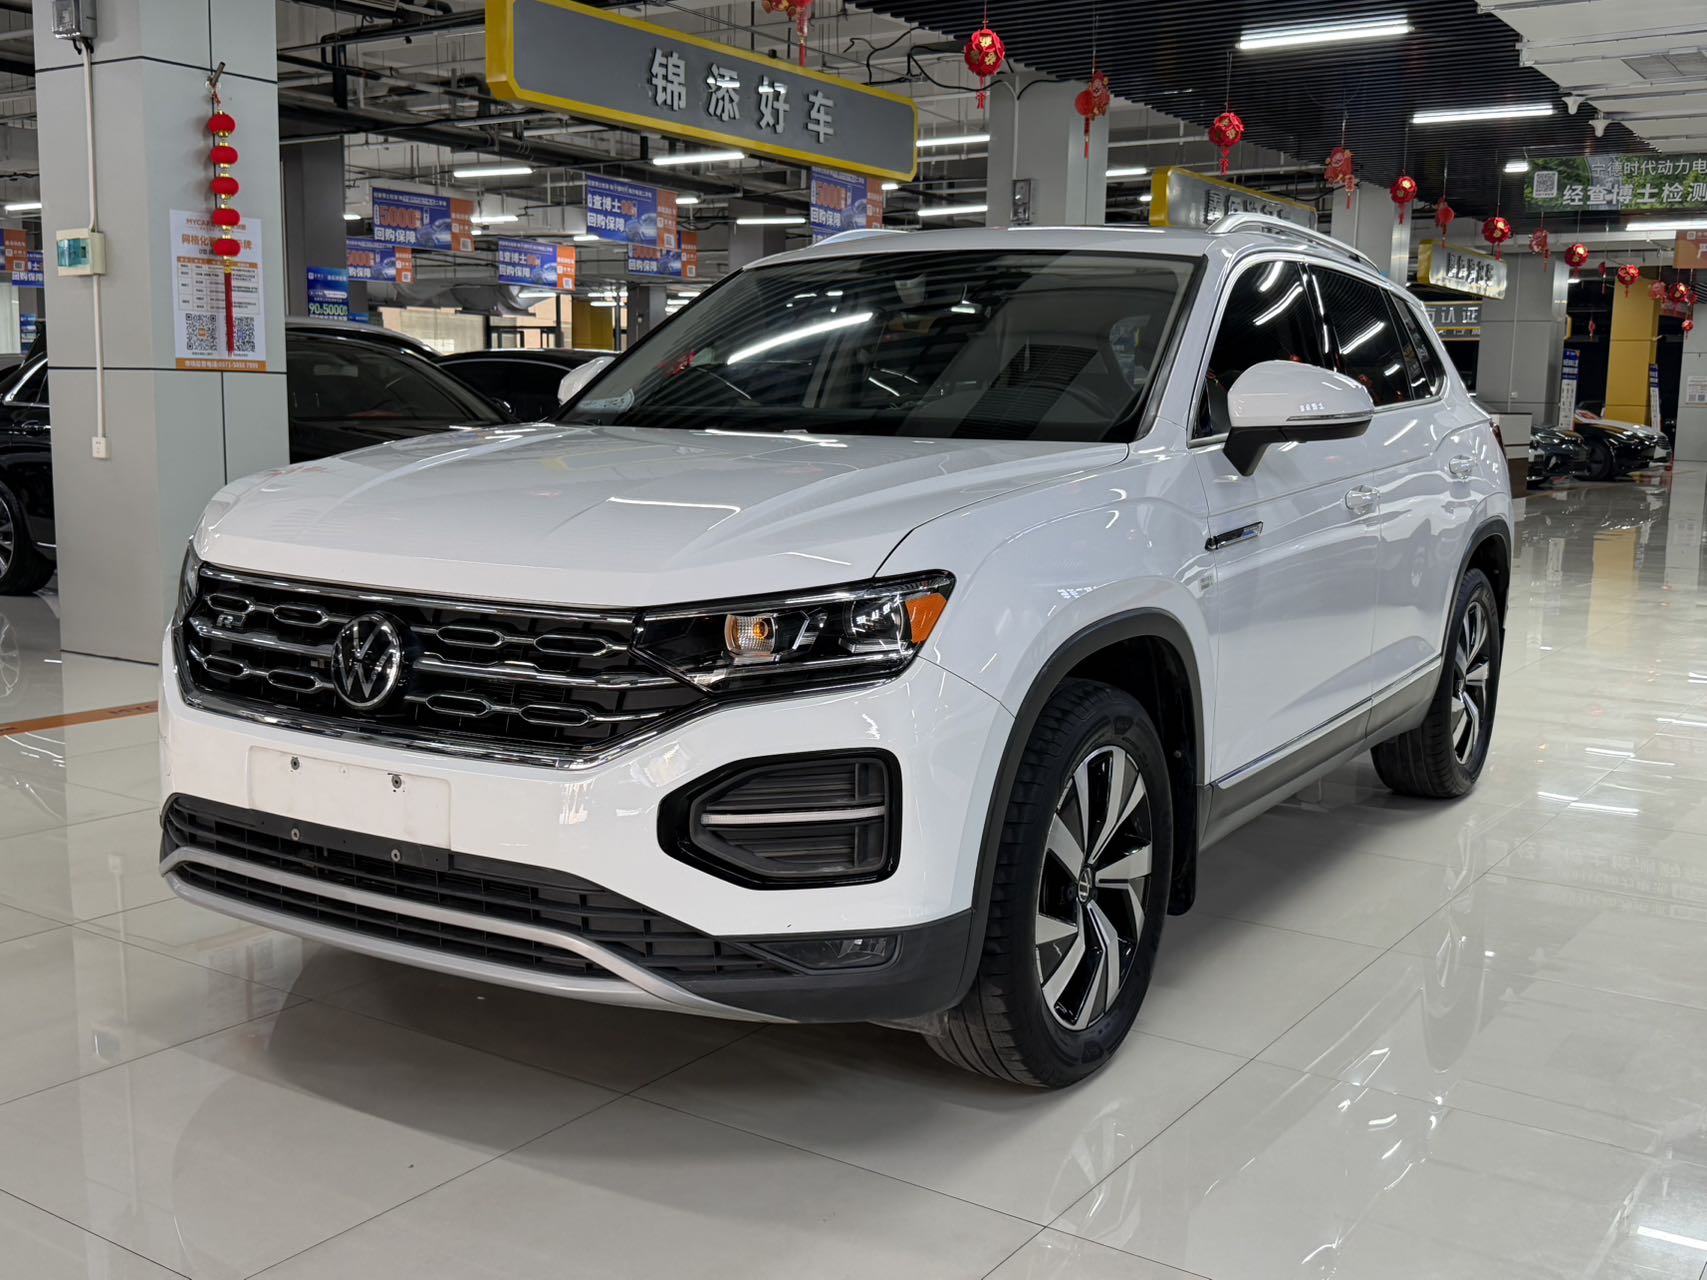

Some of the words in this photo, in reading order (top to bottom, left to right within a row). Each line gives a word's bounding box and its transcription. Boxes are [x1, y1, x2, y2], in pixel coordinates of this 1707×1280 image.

[650, 47, 835, 144] 锦添好车
[1591, 158, 1707, 177] 宁德时代动力电
[1562, 181, 1707, 206] 经查博士检测
[587, 212, 626, 233] 回购保障
[374, 227, 417, 244] 回购保障
[499, 264, 531, 278] 回购保障
[628, 258, 658, 273] 回购保障
